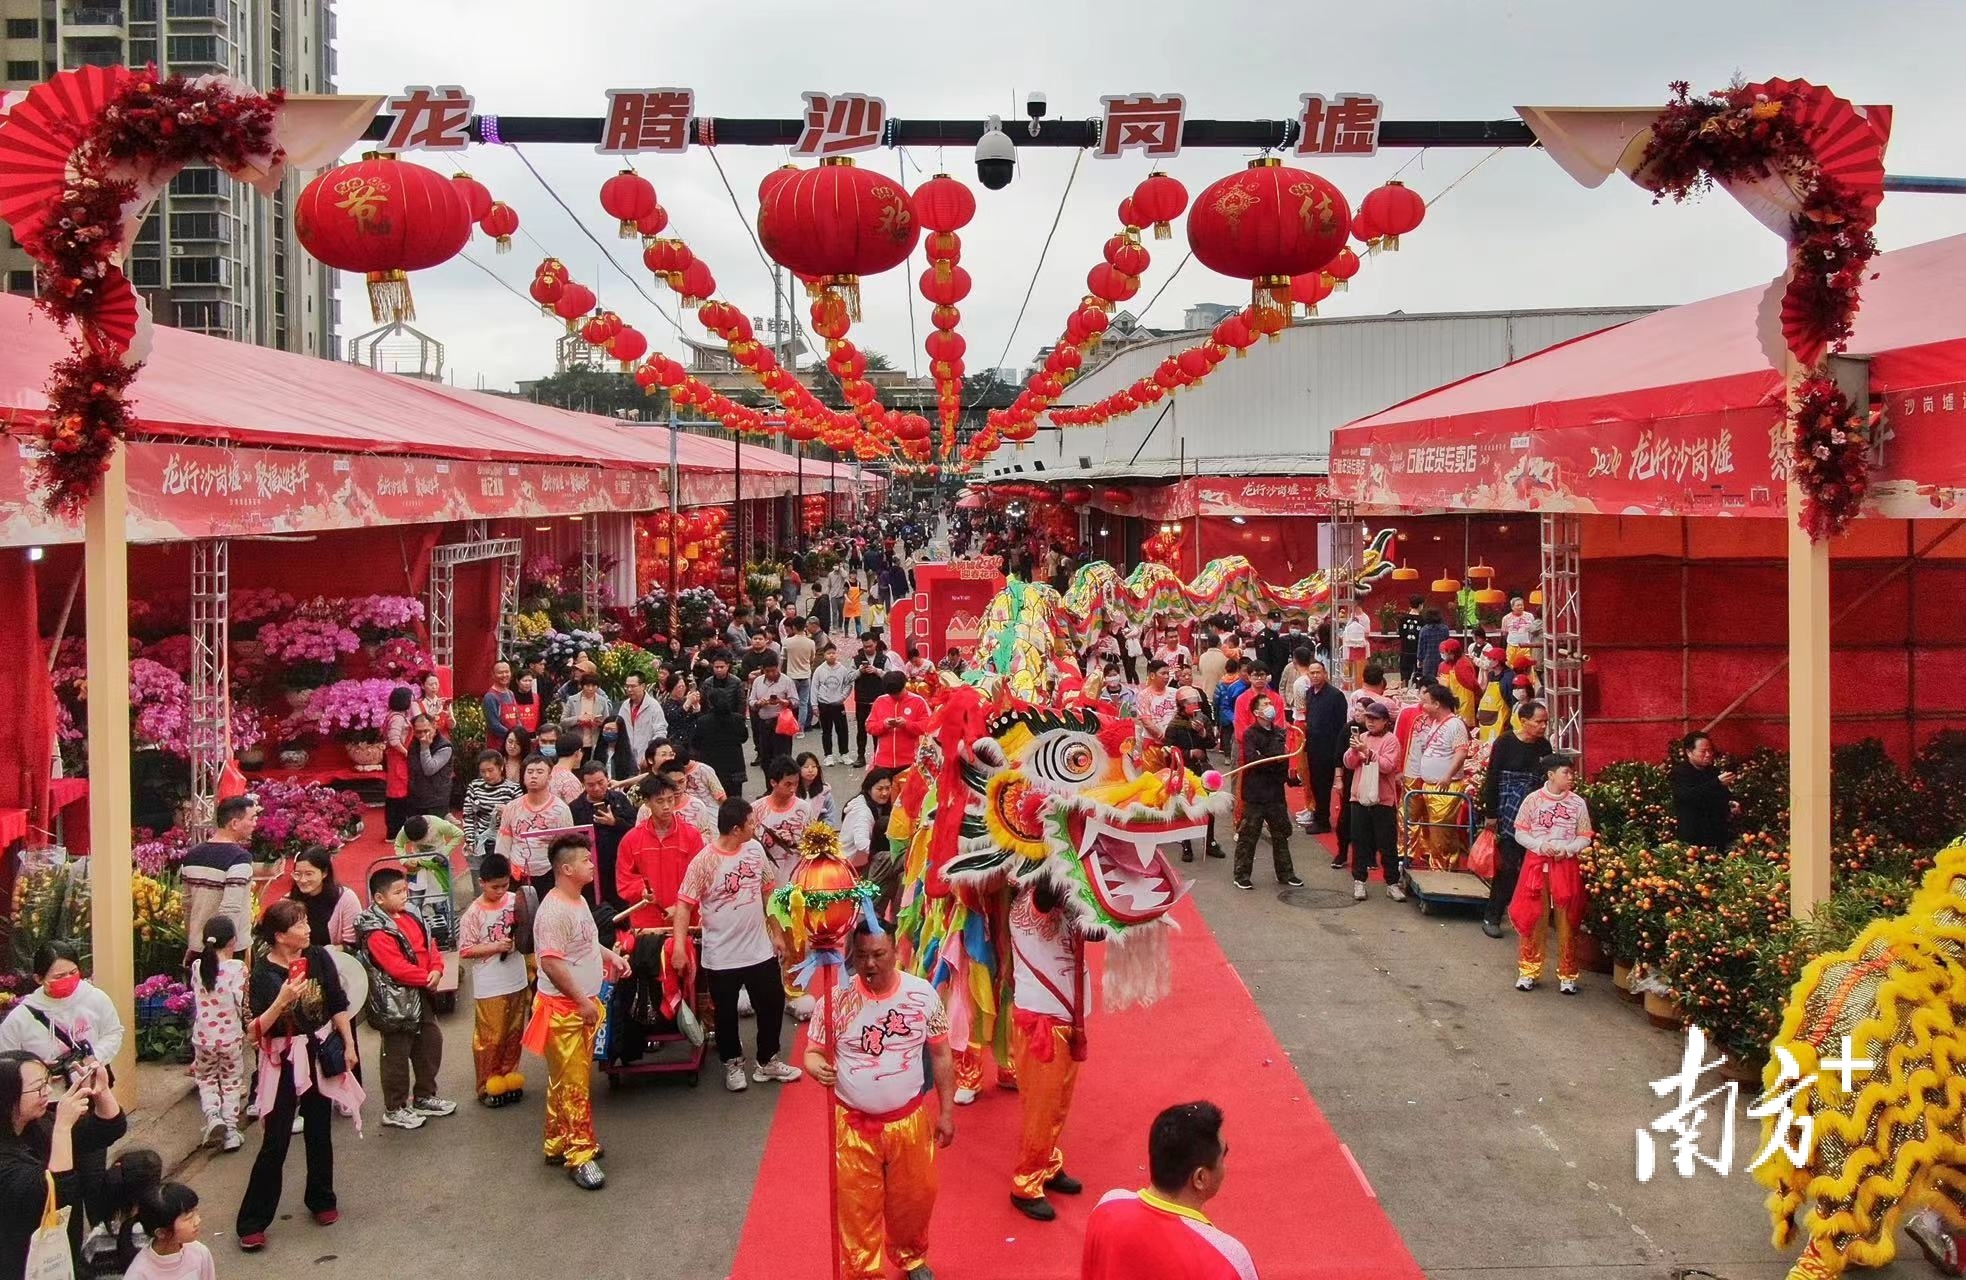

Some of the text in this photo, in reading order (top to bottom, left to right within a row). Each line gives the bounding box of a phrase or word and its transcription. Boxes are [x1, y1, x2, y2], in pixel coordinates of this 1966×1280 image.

[377, 85, 1383, 159] 龙腾沙岗墟
[1904, 391, 1966, 416] 沙岗墟
[162, 452, 242, 497] 龙行沙岗墟
[1628, 428, 1735, 483] 龙行沙岗墟
[1240, 481, 1300, 497] 龙行沙岗墟
